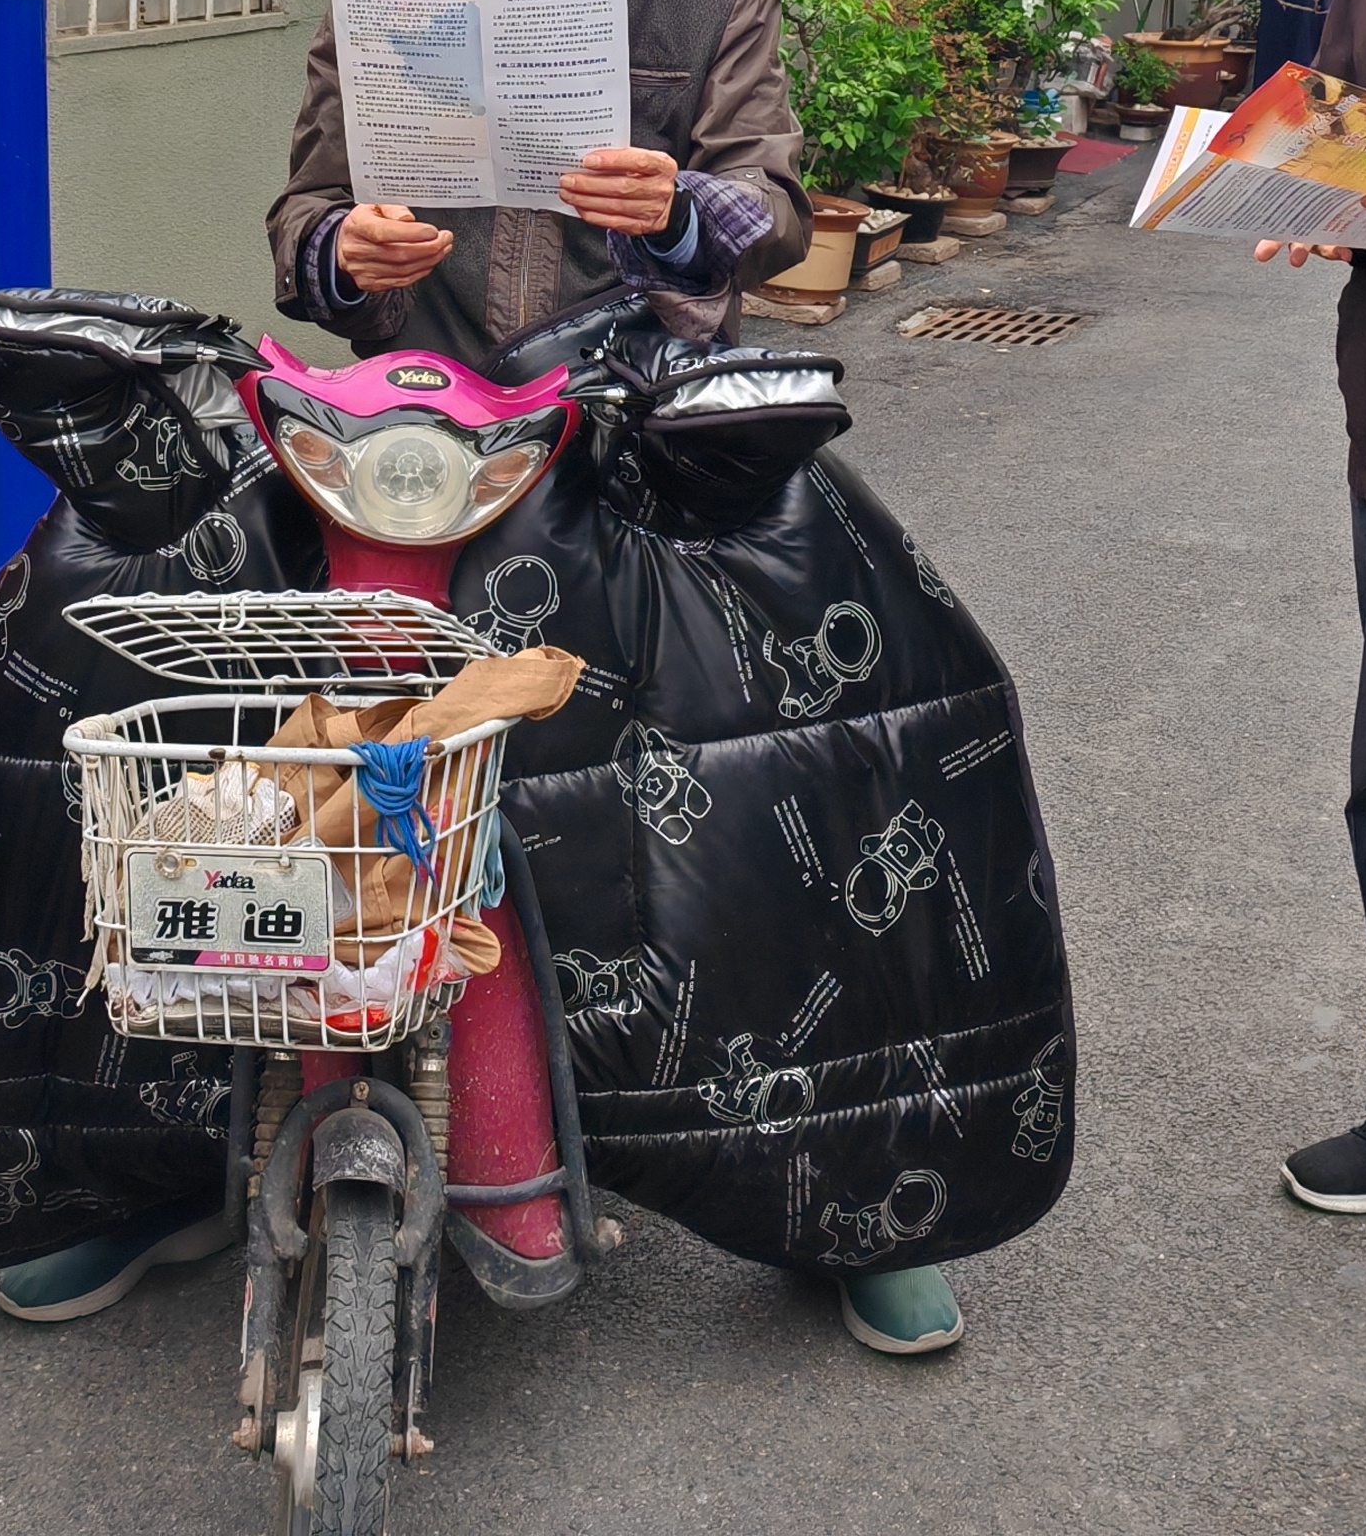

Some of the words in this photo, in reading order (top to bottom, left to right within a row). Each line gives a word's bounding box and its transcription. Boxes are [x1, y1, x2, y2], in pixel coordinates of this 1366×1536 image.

[398, 370, 444, 386] Yadea
[612, 698, 623, 710] 01
[59, 707, 73, 720] 01
[204, 870, 256, 891] Yadea
[155, 899, 304, 945] 雅迪
[220, 953, 304, 967] 中国驰名商标
